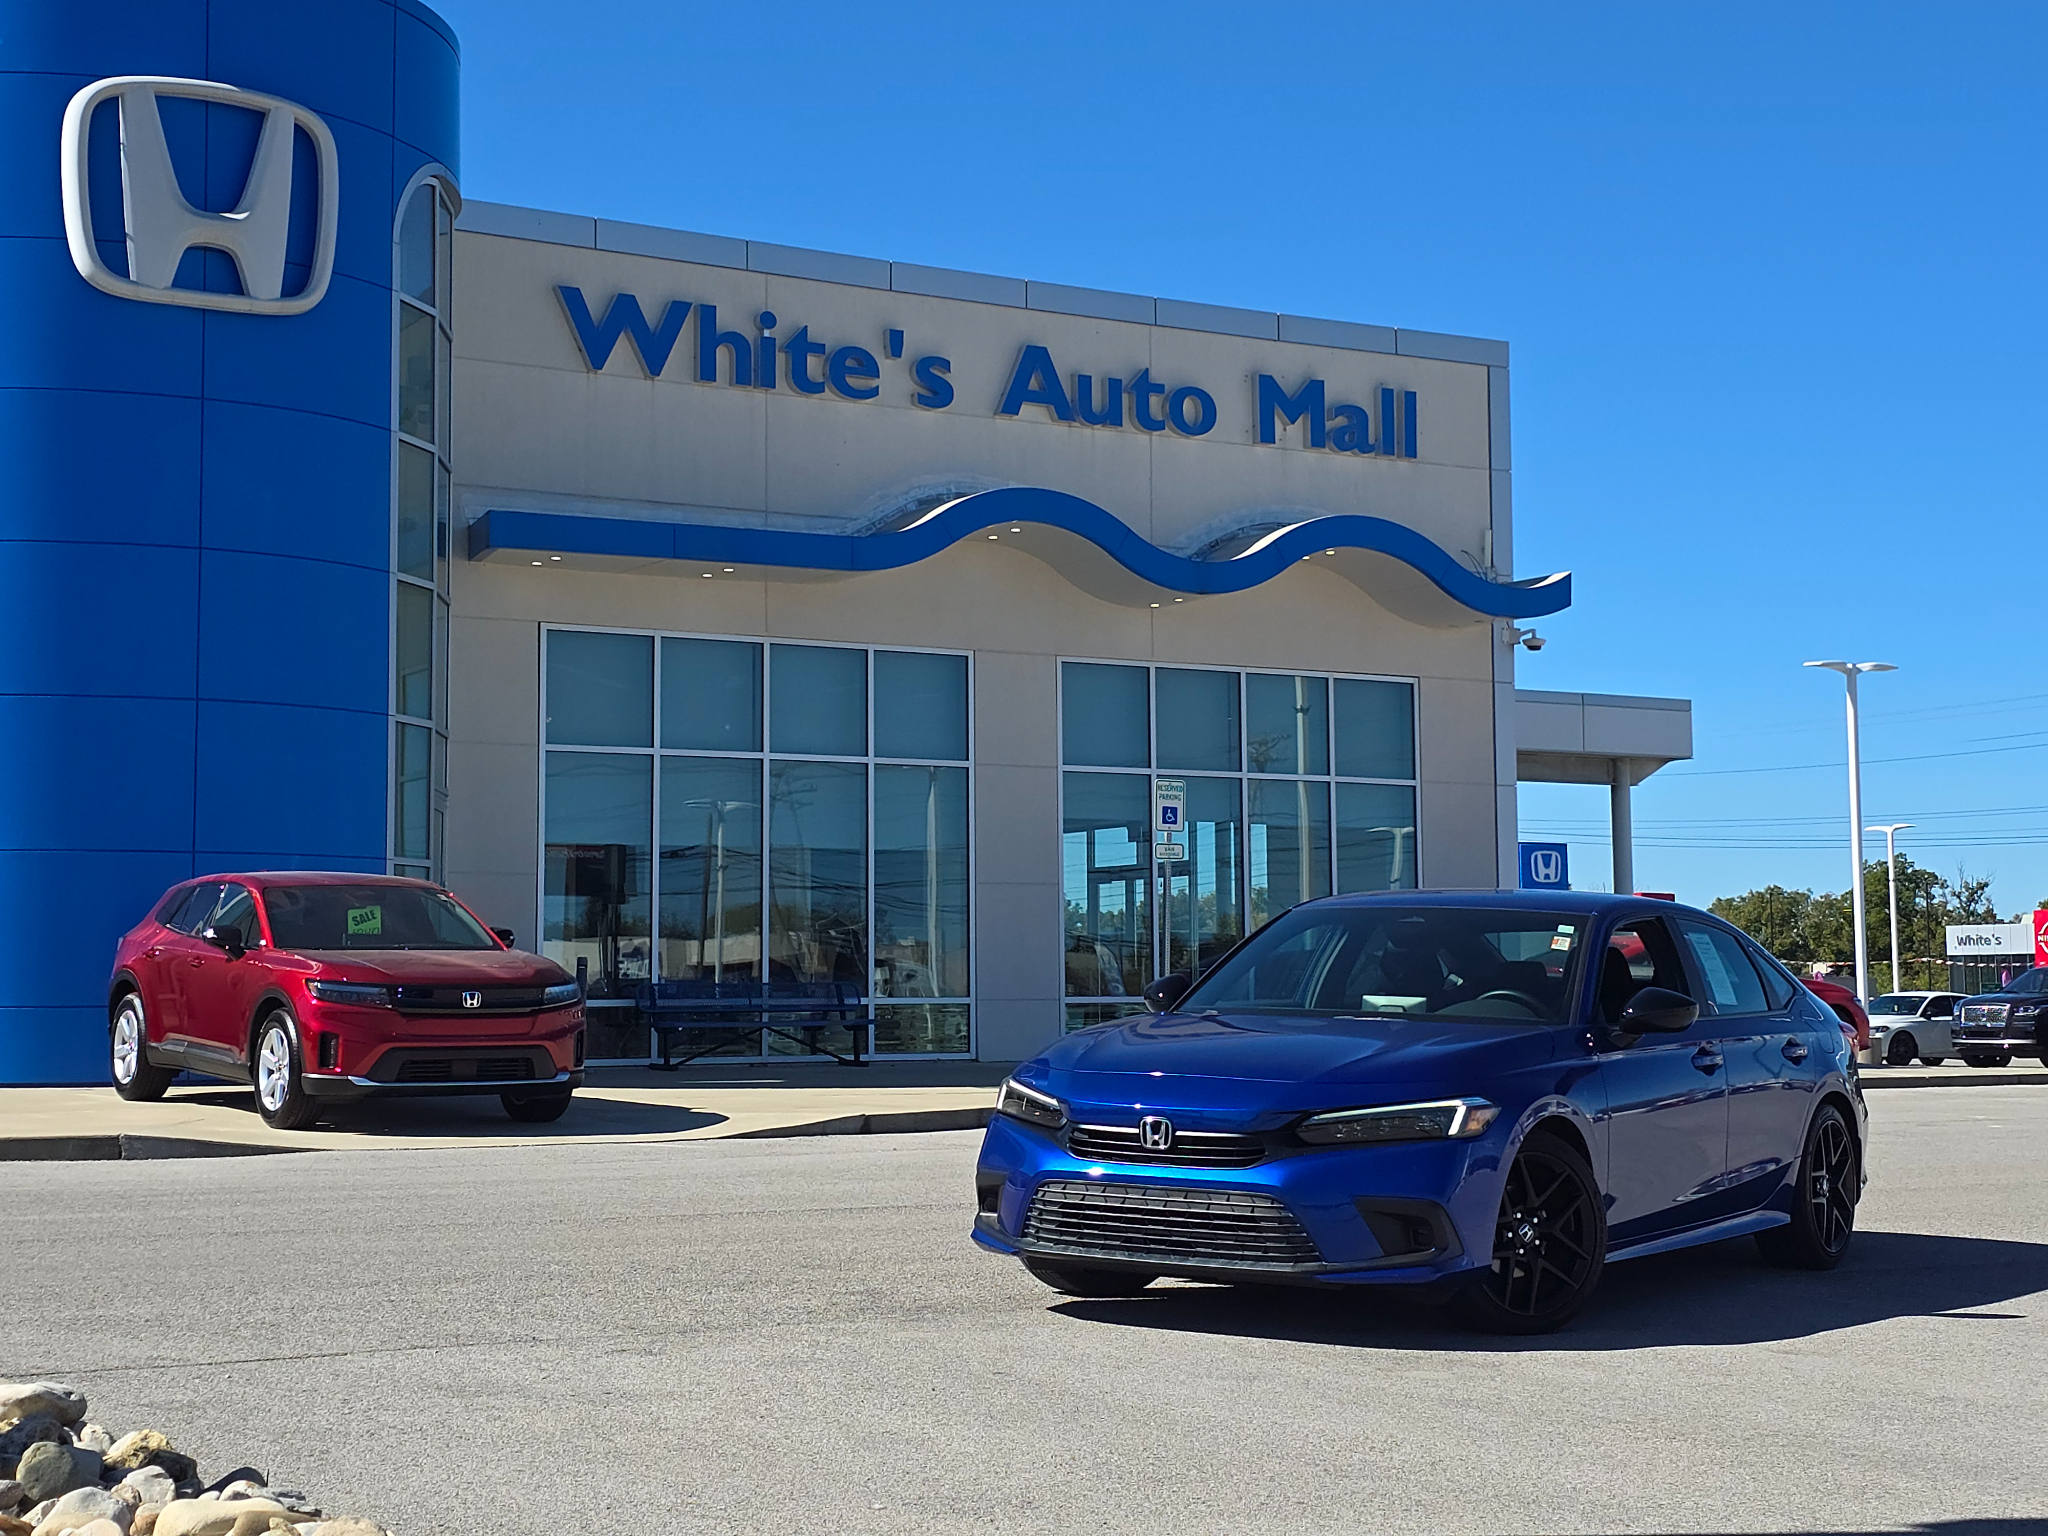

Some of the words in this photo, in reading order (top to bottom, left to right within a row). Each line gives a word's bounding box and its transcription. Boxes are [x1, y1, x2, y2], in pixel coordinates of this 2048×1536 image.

[554, 285, 955, 411] White's
[996, 344, 1218, 437] Auto
[1255, 373, 1418, 460] Mall
[1158, 793, 1182, 802] PARKING
[351, 909, 378, 927] SALE
[1956, 933, 2003, 947] White's
